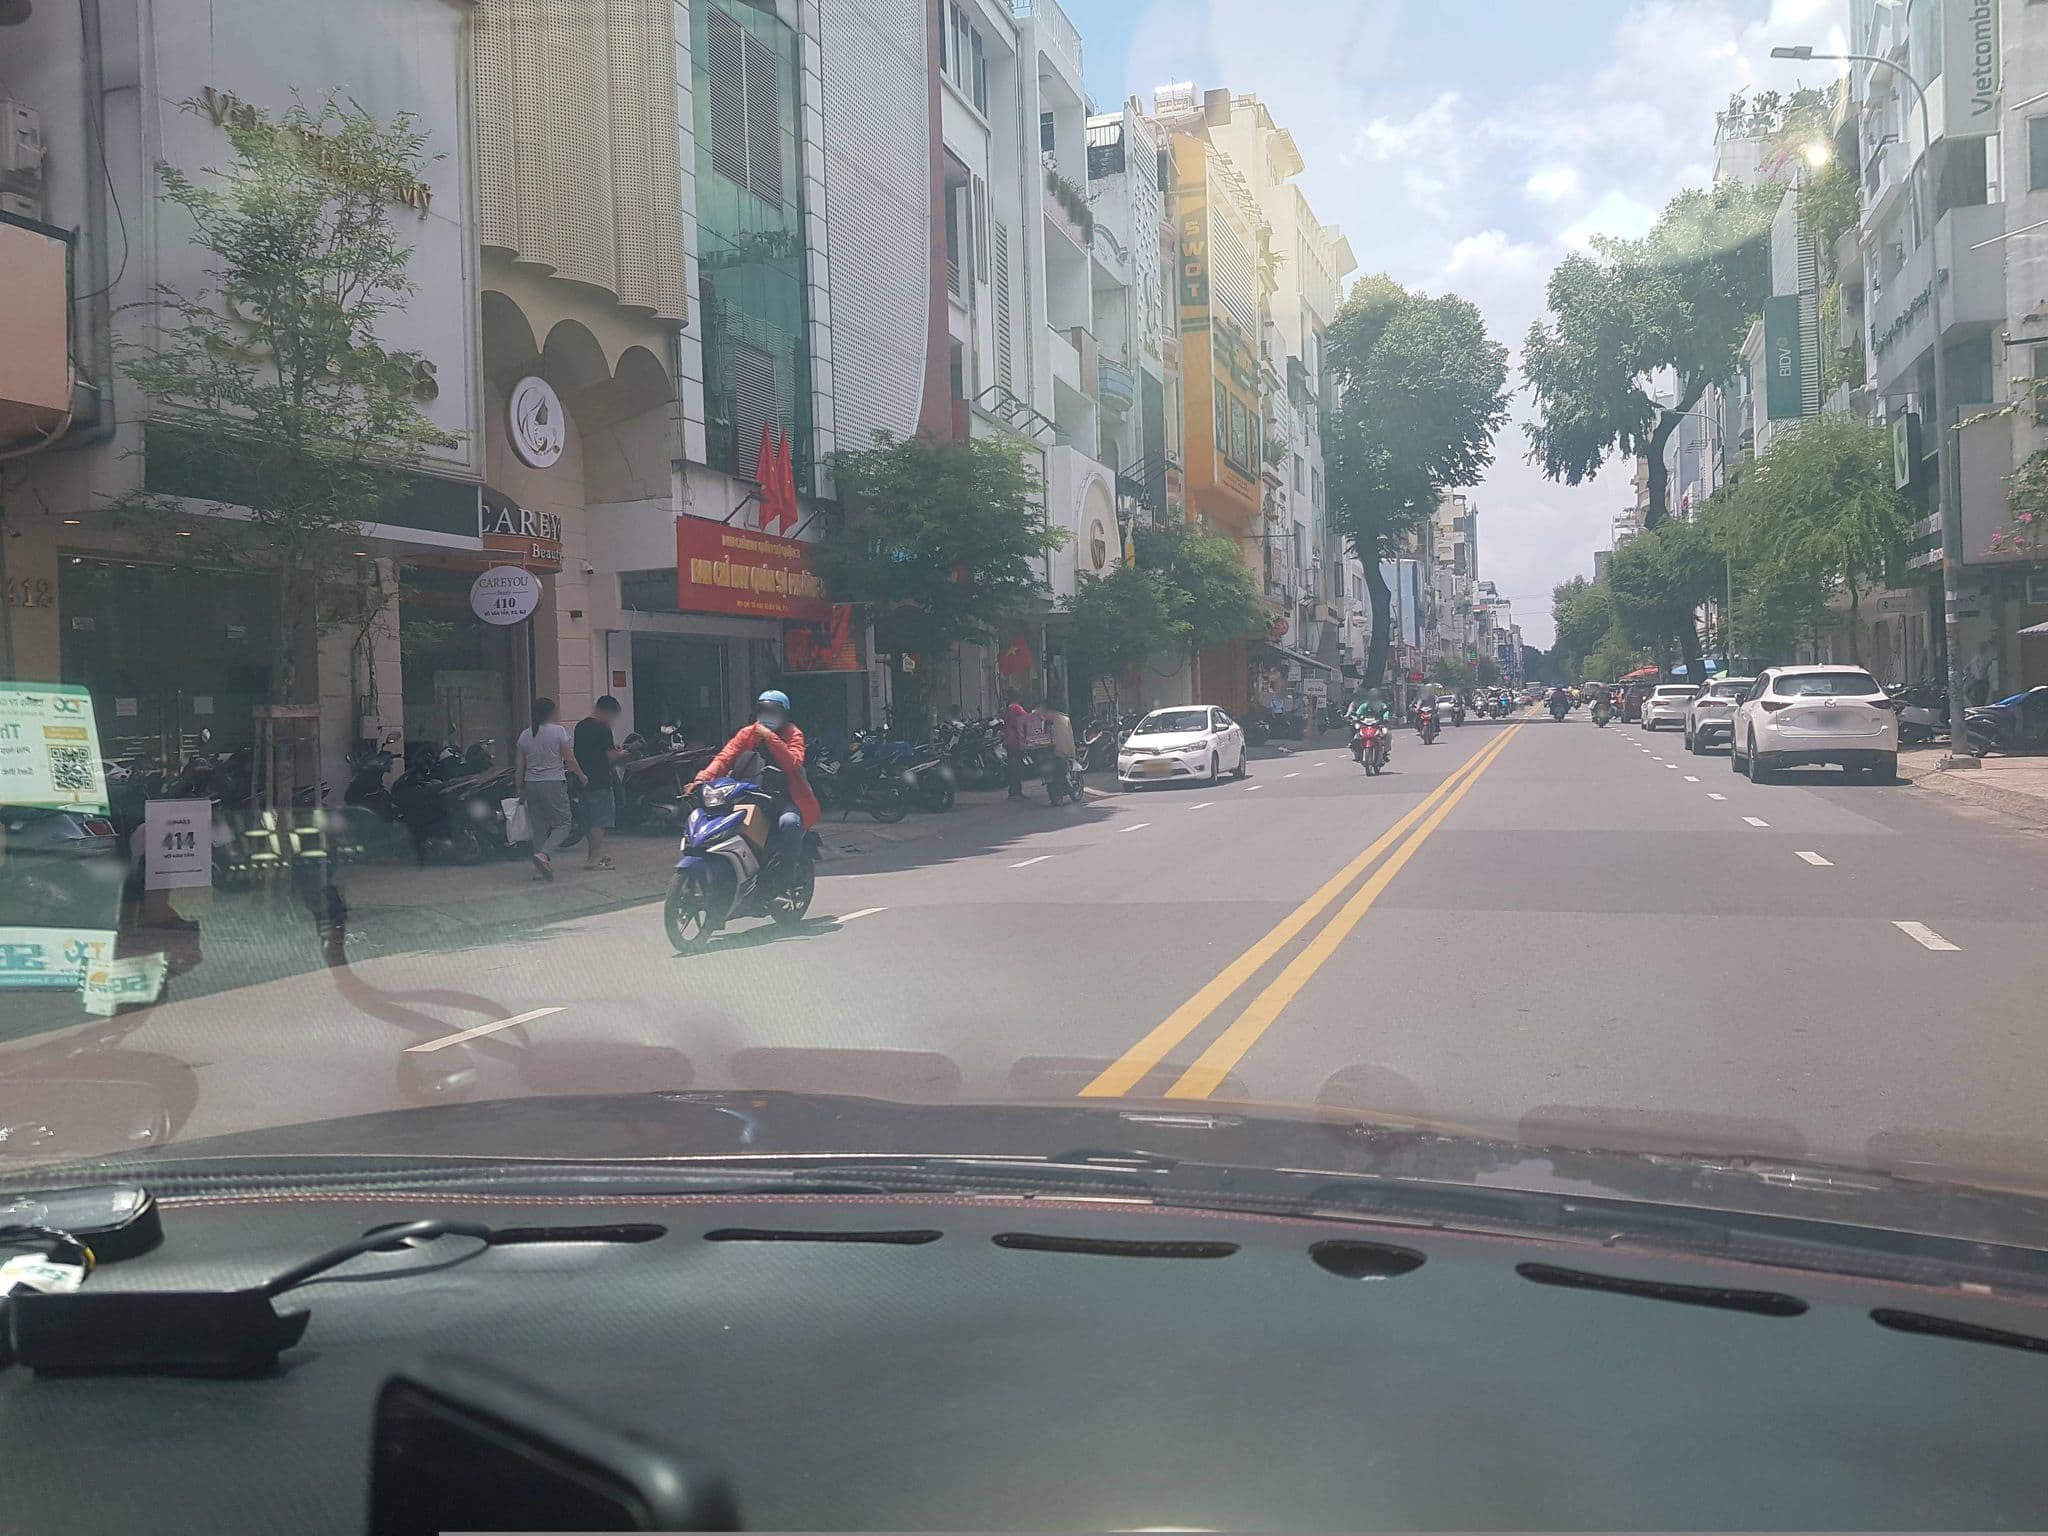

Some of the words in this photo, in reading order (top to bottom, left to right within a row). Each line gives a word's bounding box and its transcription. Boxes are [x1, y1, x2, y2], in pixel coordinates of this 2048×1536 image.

[1779, 348, 1791, 377] BIDV
[482, 505, 560, 540] CAREY
[479, 576, 528, 588] CAREYOU
[493, 597, 516, 609] 410
[161, 831, 195, 850] 414
